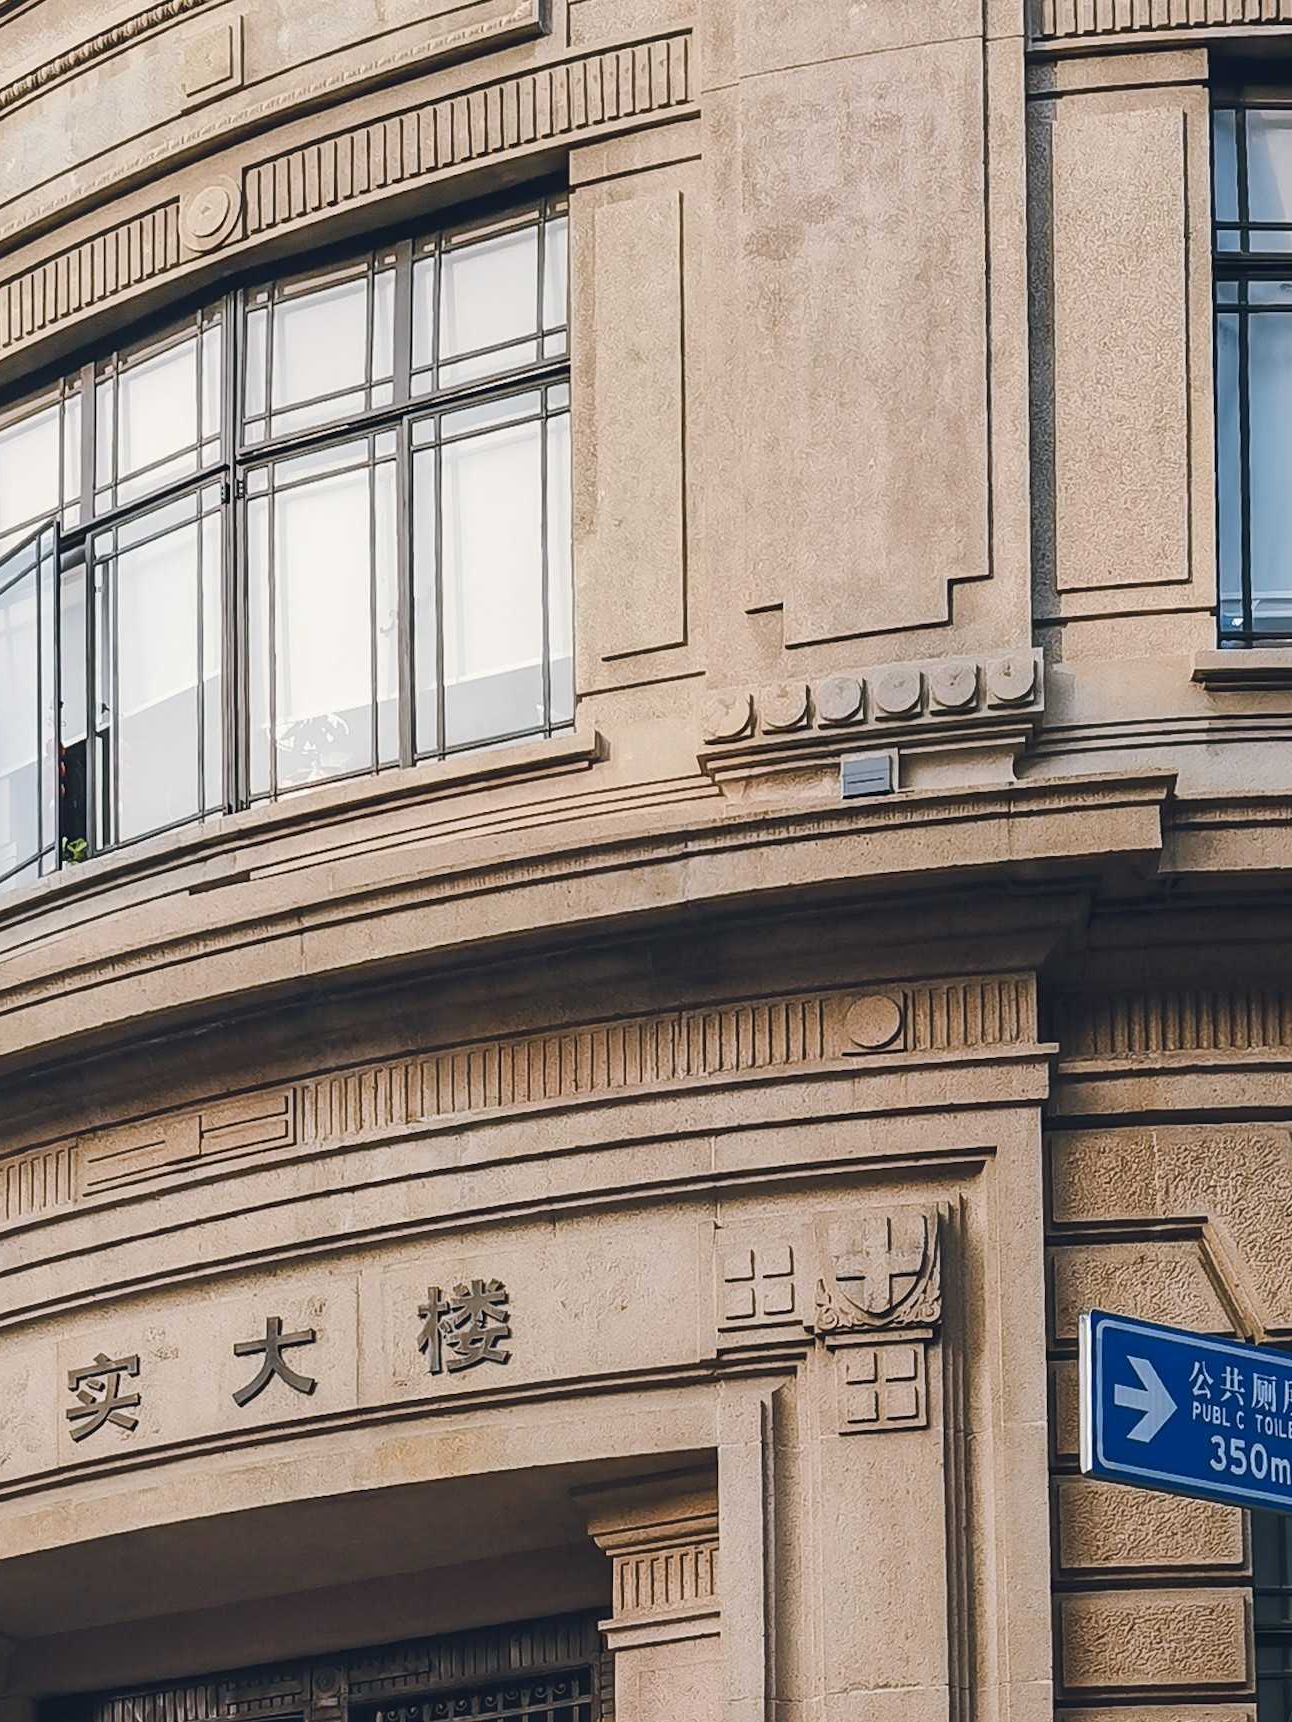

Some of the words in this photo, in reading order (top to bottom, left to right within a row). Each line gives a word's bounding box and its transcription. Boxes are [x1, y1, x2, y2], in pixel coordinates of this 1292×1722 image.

[1188, 1360, 1292, 1413] 公共厕
[1192, 1401, 1245, 1430] PUBLC
[1209, 1434, 1292, 1486] 350m
